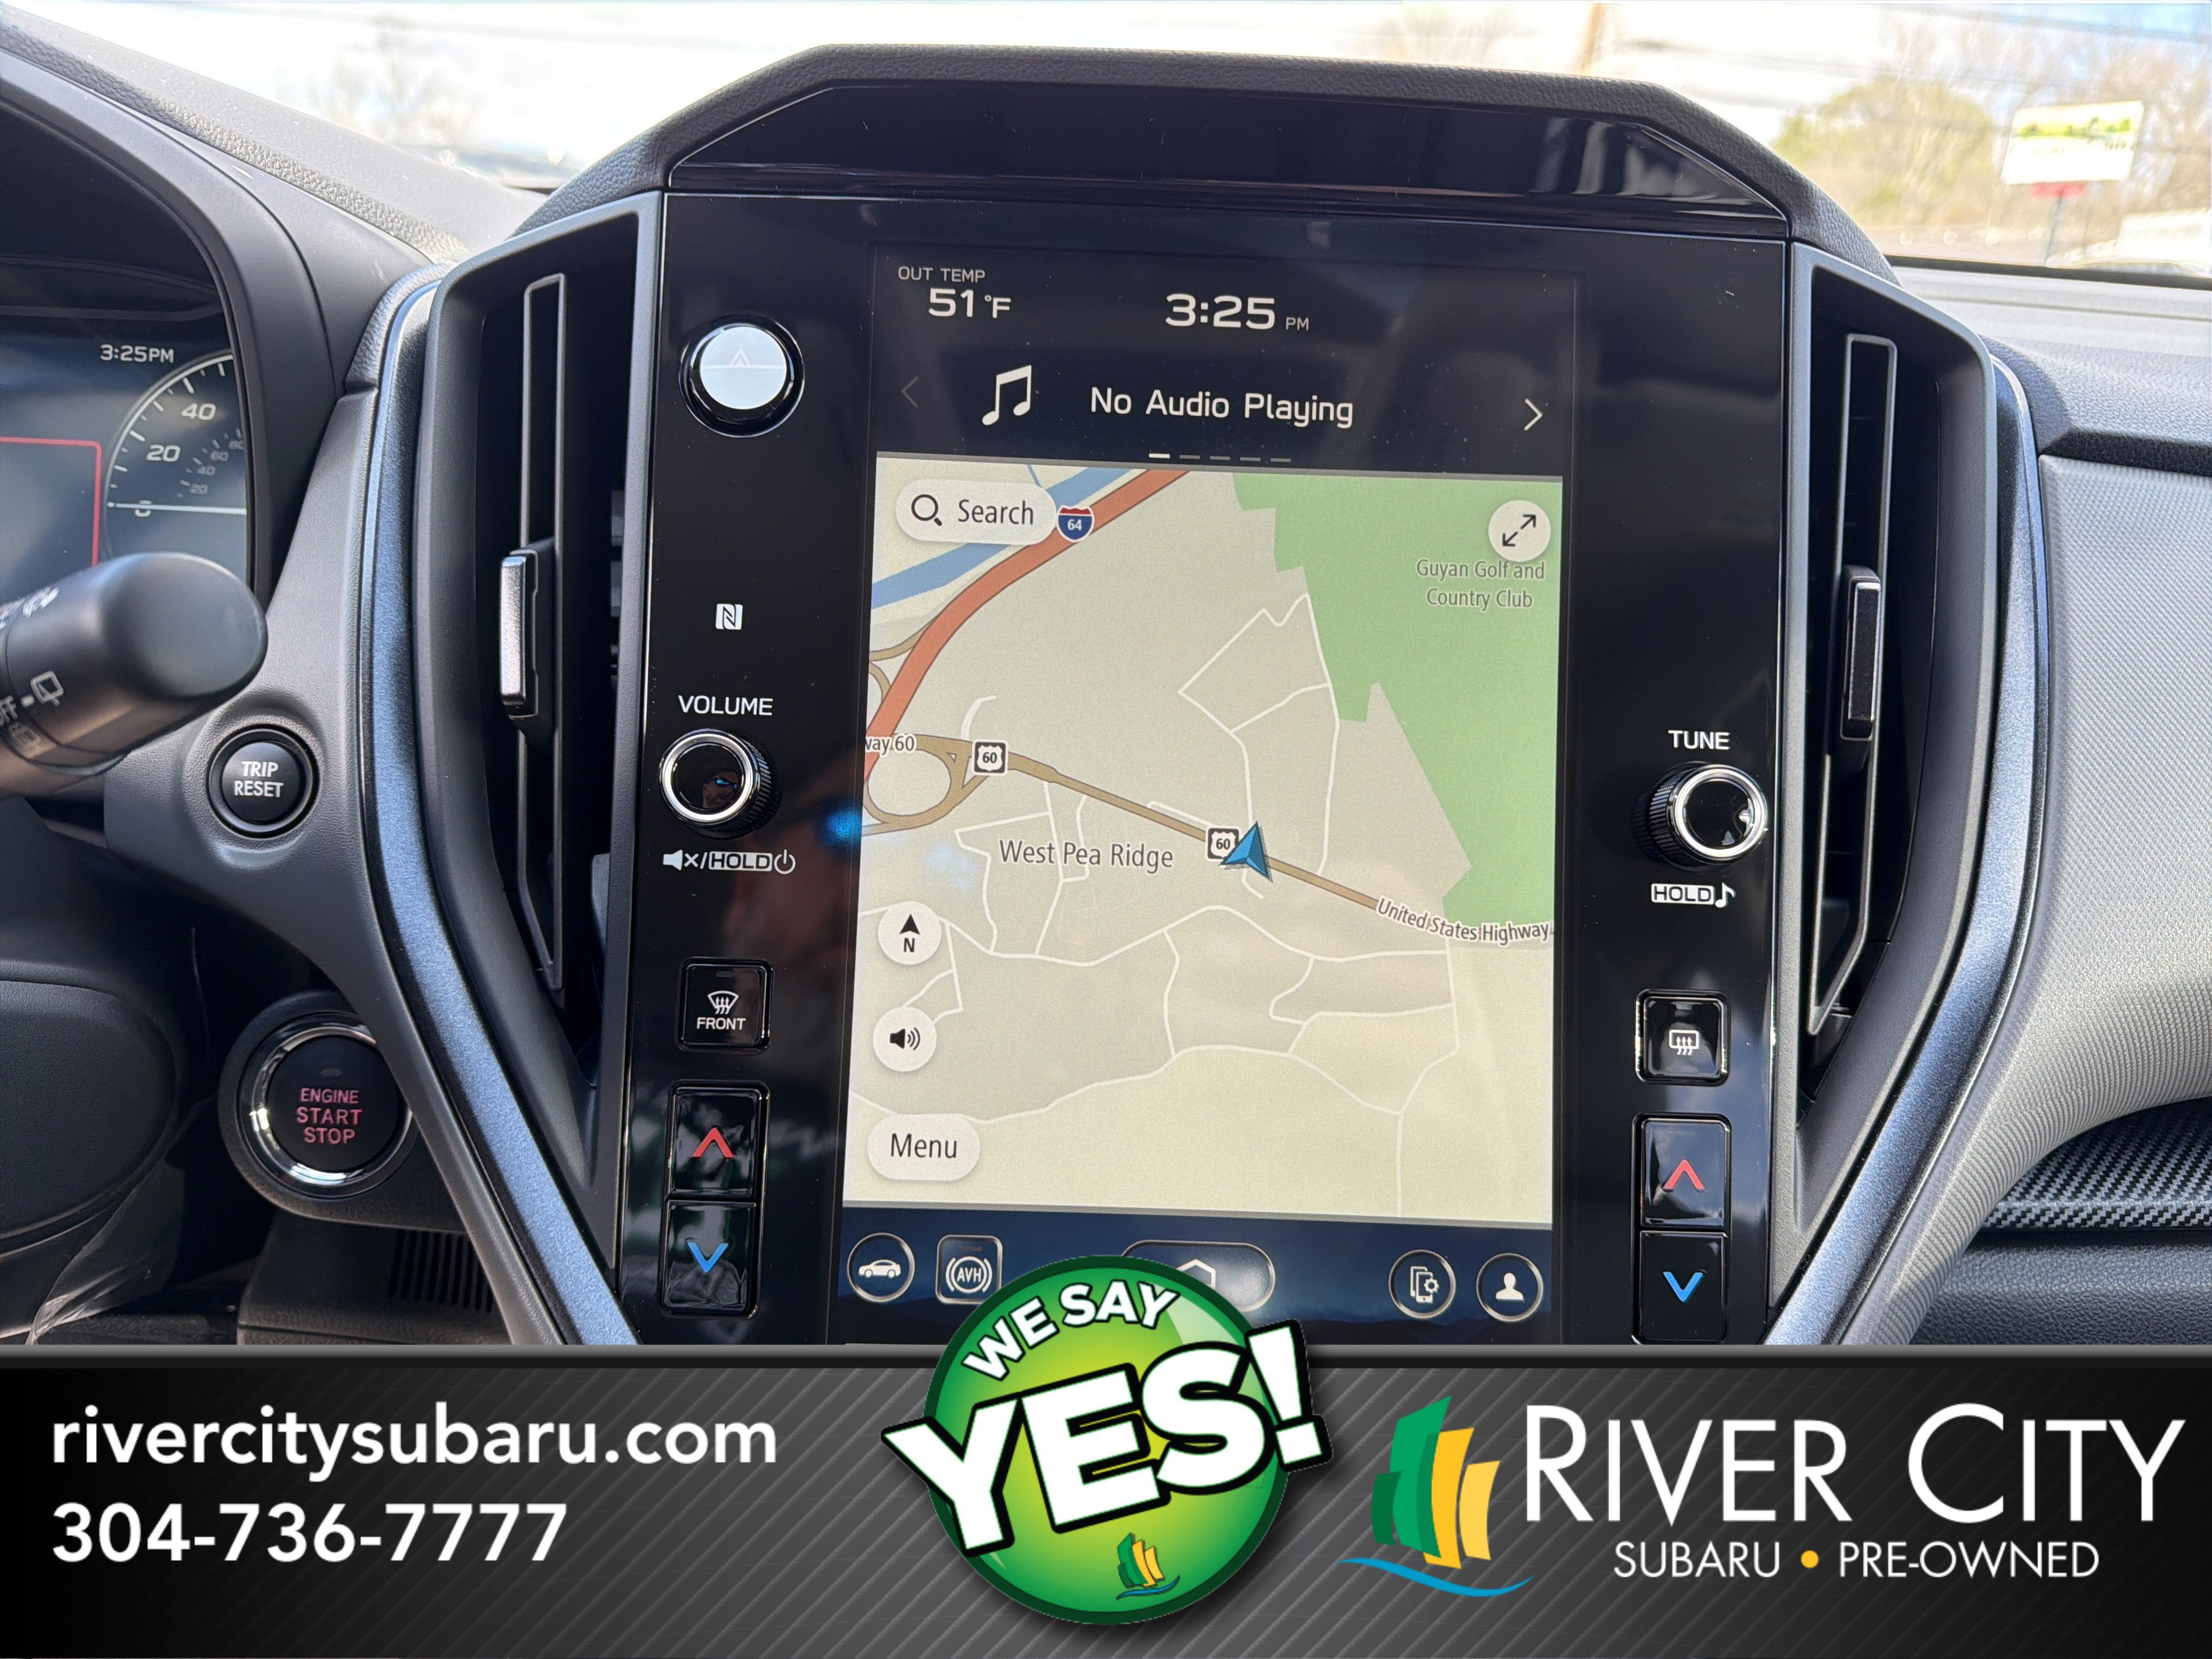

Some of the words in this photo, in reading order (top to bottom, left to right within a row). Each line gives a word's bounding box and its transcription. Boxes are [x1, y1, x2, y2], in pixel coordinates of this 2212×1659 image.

[898, 266, 934, 281] OUT
[940, 268, 985, 283] TEMP
[1165, 294, 1275, 330] 3:25
[1285, 317, 1309, 331] PM
[180, 403, 216, 420] 40
[1091, 387, 1132, 414] No
[1146, 390, 1229, 418] Audio
[1245, 393, 1353, 429] Playing
[146, 444, 180, 462] 20
[958, 499, 1034, 525] Search
[1067, 518, 1082, 531] 64
[1417, 559, 1469, 582] Guyan
[1475, 560, 1508, 578] Golf
[1513, 561, 1545, 579] and
[1426, 588, 1491, 612] Country
[1496, 589, 1532, 608] Club
[678, 695, 774, 716] VOLUME
[895, 735, 915, 752] 60
[1668, 730, 1730, 750] TUNE
[982, 752, 997, 764] 60
[241, 760, 279, 778] TRIP
[234, 780, 284, 798] RESET
[1216, 838, 1231, 850] 60
[1000, 839, 1056, 864] West
[1064, 843, 1101, 865] Pea
[1111, 845, 1173, 873] Ridge
[1654, 887, 1712, 902] HOLD
[1378, 898, 1428, 929] United
[1430, 917, 1477, 940] States
[1482, 923, 1550, 946] Highway
[903, 938, 915, 953] N
[696, 1017, 747, 1030] FRONT
[300, 1087, 359, 1104] ENGINE
[297, 1106, 363, 1125] START
[304, 1126, 356, 1144] STOP
[890, 1133, 958, 1159] Menu
[957, 1267, 981, 1283] AVH
